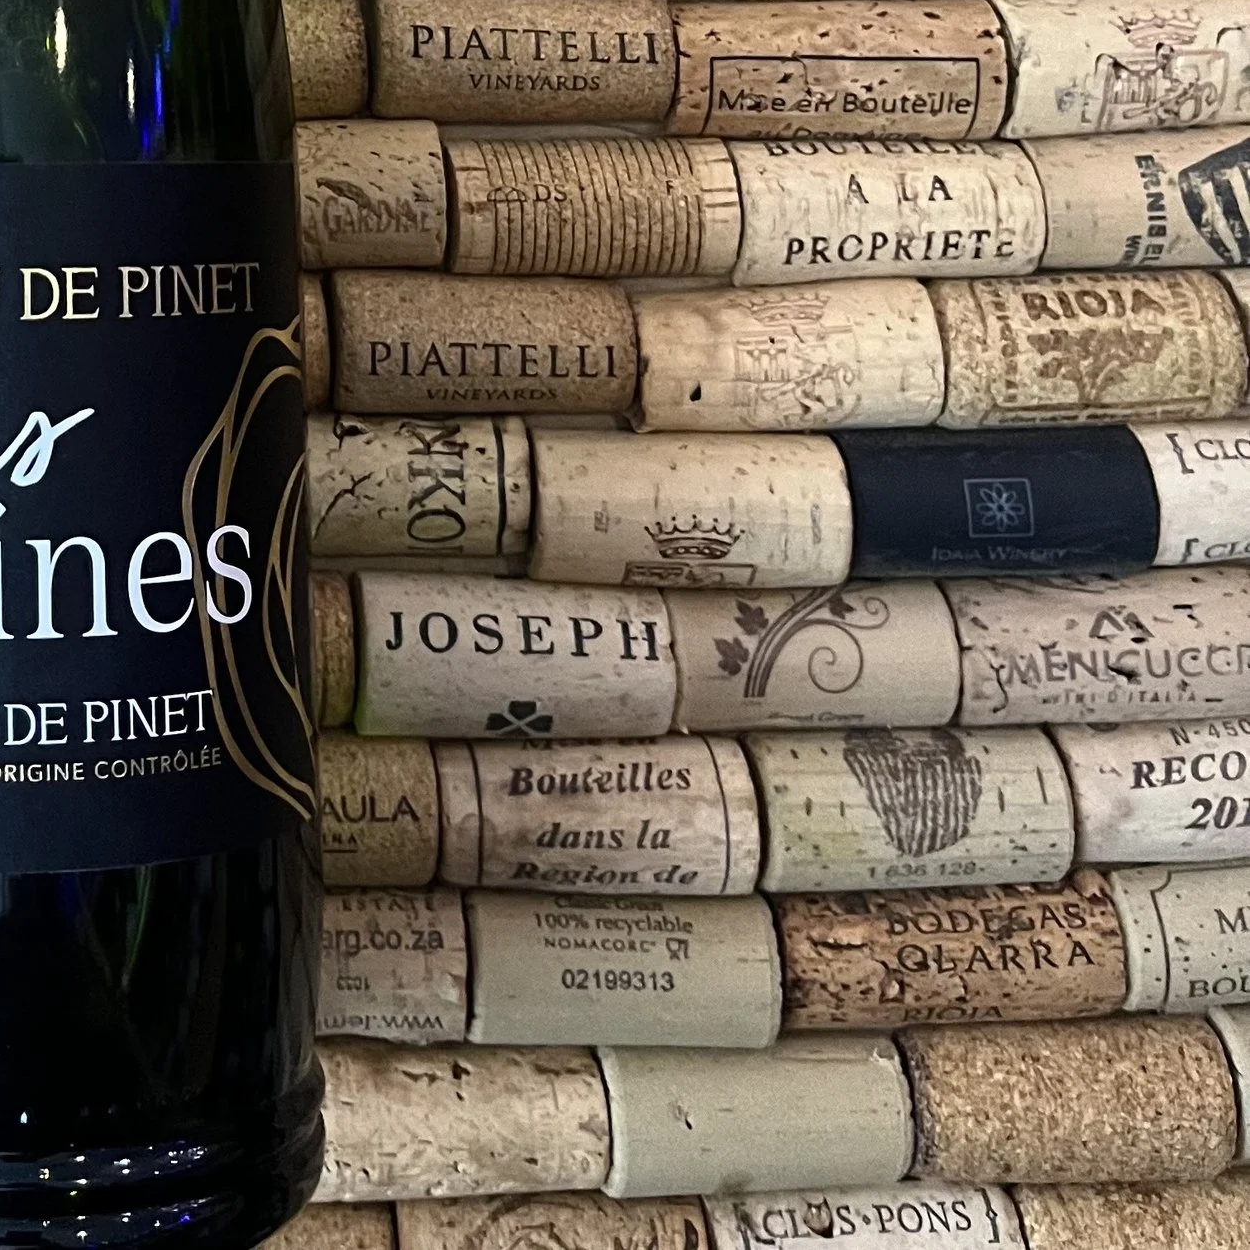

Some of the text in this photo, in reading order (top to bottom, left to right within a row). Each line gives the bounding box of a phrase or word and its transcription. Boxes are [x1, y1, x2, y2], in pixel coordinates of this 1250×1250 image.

[410, 24, 662, 66] PIATTELLI
[469, 73, 601, 92] VINEYARDS
[843, 90, 972, 116] Bouteille
[784, 229, 1016, 265] PROPRIETE
[20, 266, 100, 321] DE
[117, 261, 260, 318] PINET
[1021, 287, 1166, 321] RIOJA
[368, 340, 618, 380] PIATTELLI
[426, 388, 558, 402] VINEYARDS
[385, 610, 660, 663] JOSEPH
[3, 701, 69, 746] DE
[83, 689, 214, 743] PINET
[94, 746, 222, 780] CONTRÔLÉE
[1130, 750, 1248, 790] RECO
[508, 764, 692, 797] Bouteilles
[321, 794, 420, 823] AULA
[535, 820, 671, 850] dans la
[534, 913, 694, 936] 100% recyclable
[886, 903, 1089, 937] BODEGAS
[895, 944, 1096, 974] OLARRA
[561, 969, 675, 991] 02199313
